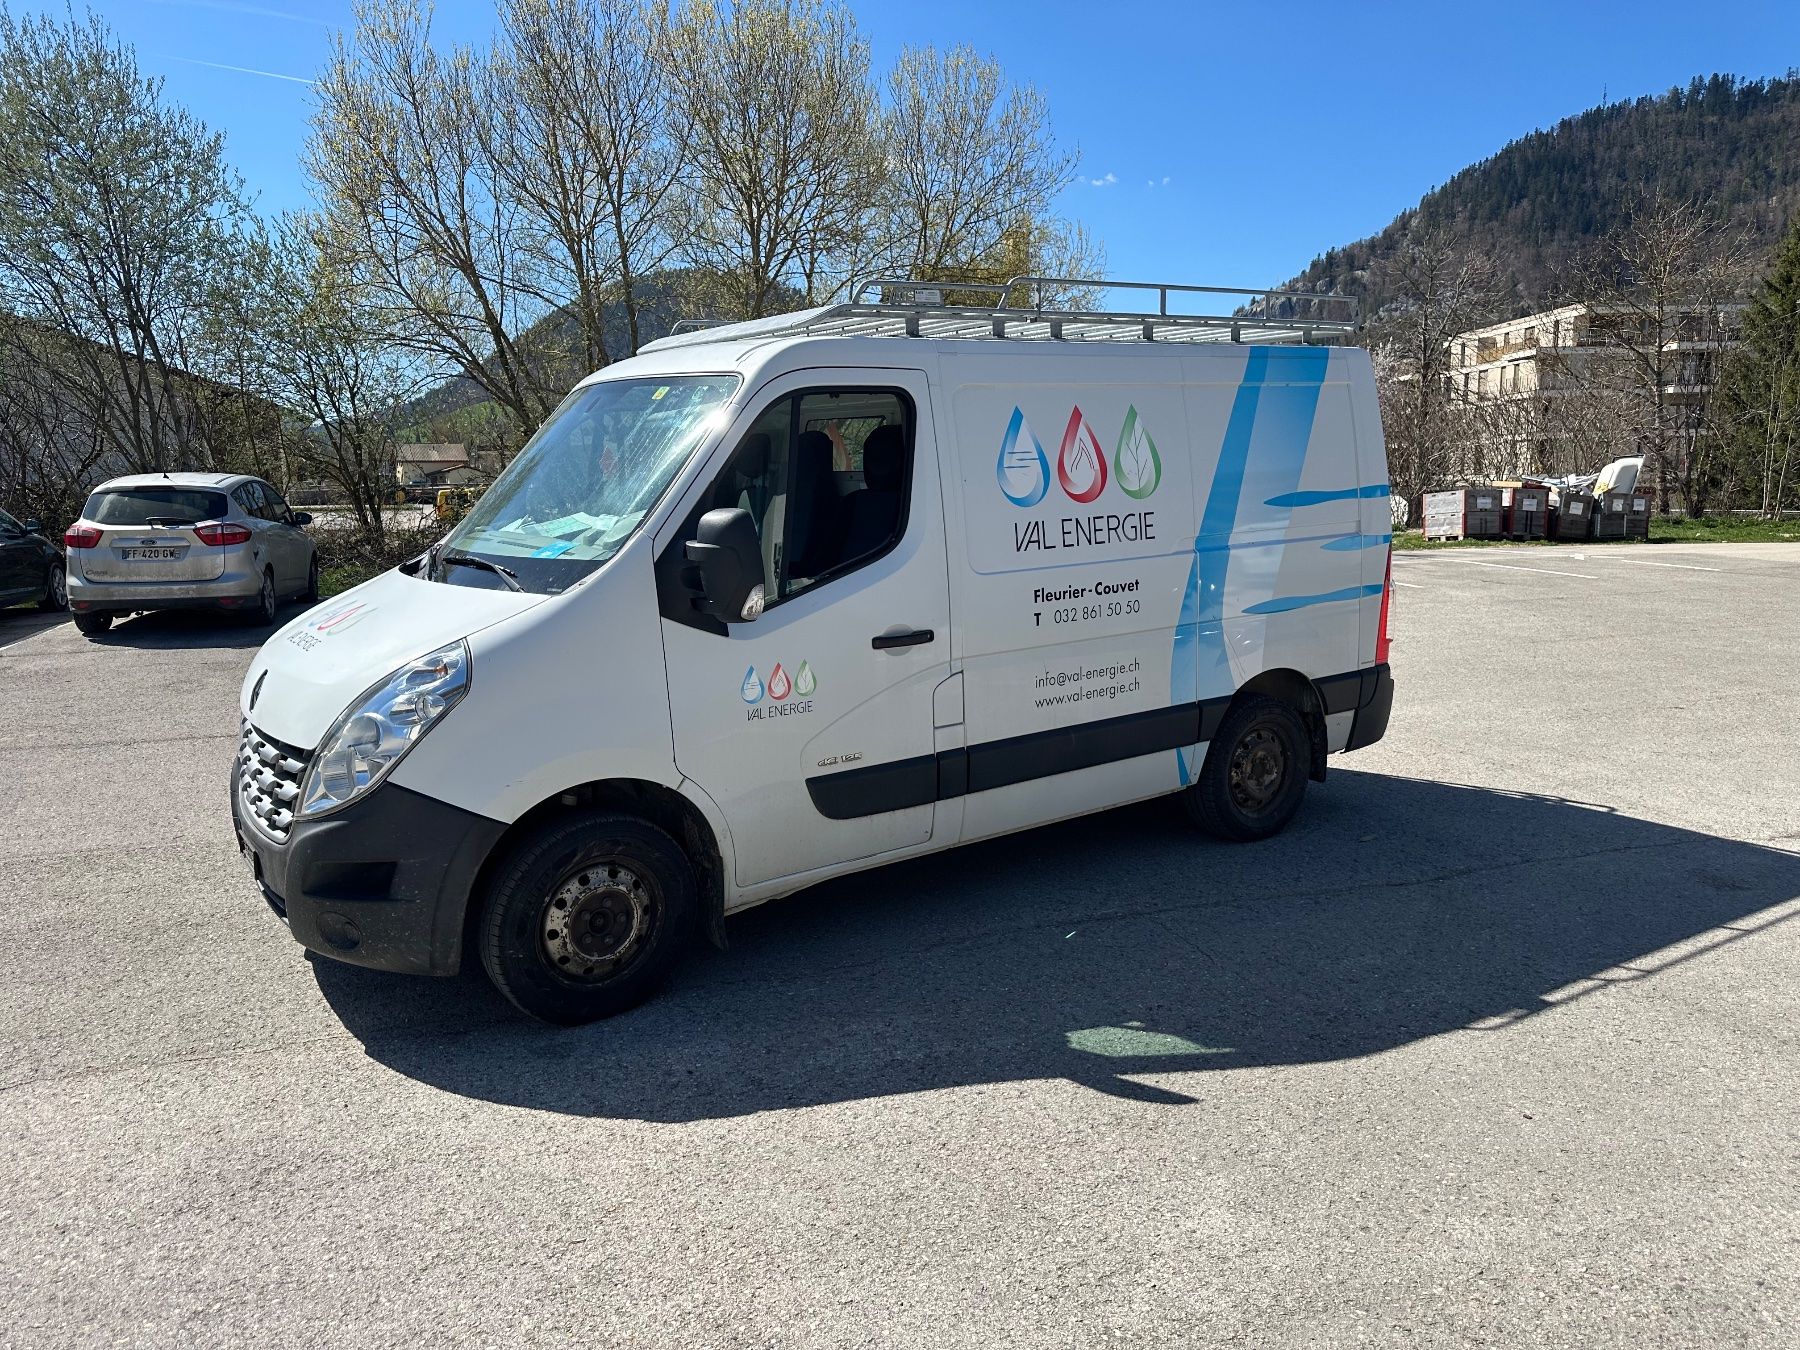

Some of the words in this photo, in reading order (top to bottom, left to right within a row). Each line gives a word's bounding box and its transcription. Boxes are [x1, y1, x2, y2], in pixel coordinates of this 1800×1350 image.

[1014, 520, 1056, 552] VAL
[1061, 512, 1156, 548] ENERGIE
[1033, 579, 1140, 603] Fleurier-Couvet
[1033, 612, 1042, 626] T
[1053, 608, 1078, 624] 032
[1082, 604, 1102, 620] 861
[1106, 602, 1122, 617] 50
[1125, 600, 1141, 614] 50
[1035, 657, 1140, 688] info@val-energie.ch
[1034, 677, 1140, 708] www.val-energie.ch
[747, 708, 766, 721] VAL
[768, 700, 813, 718] ENERGIE
